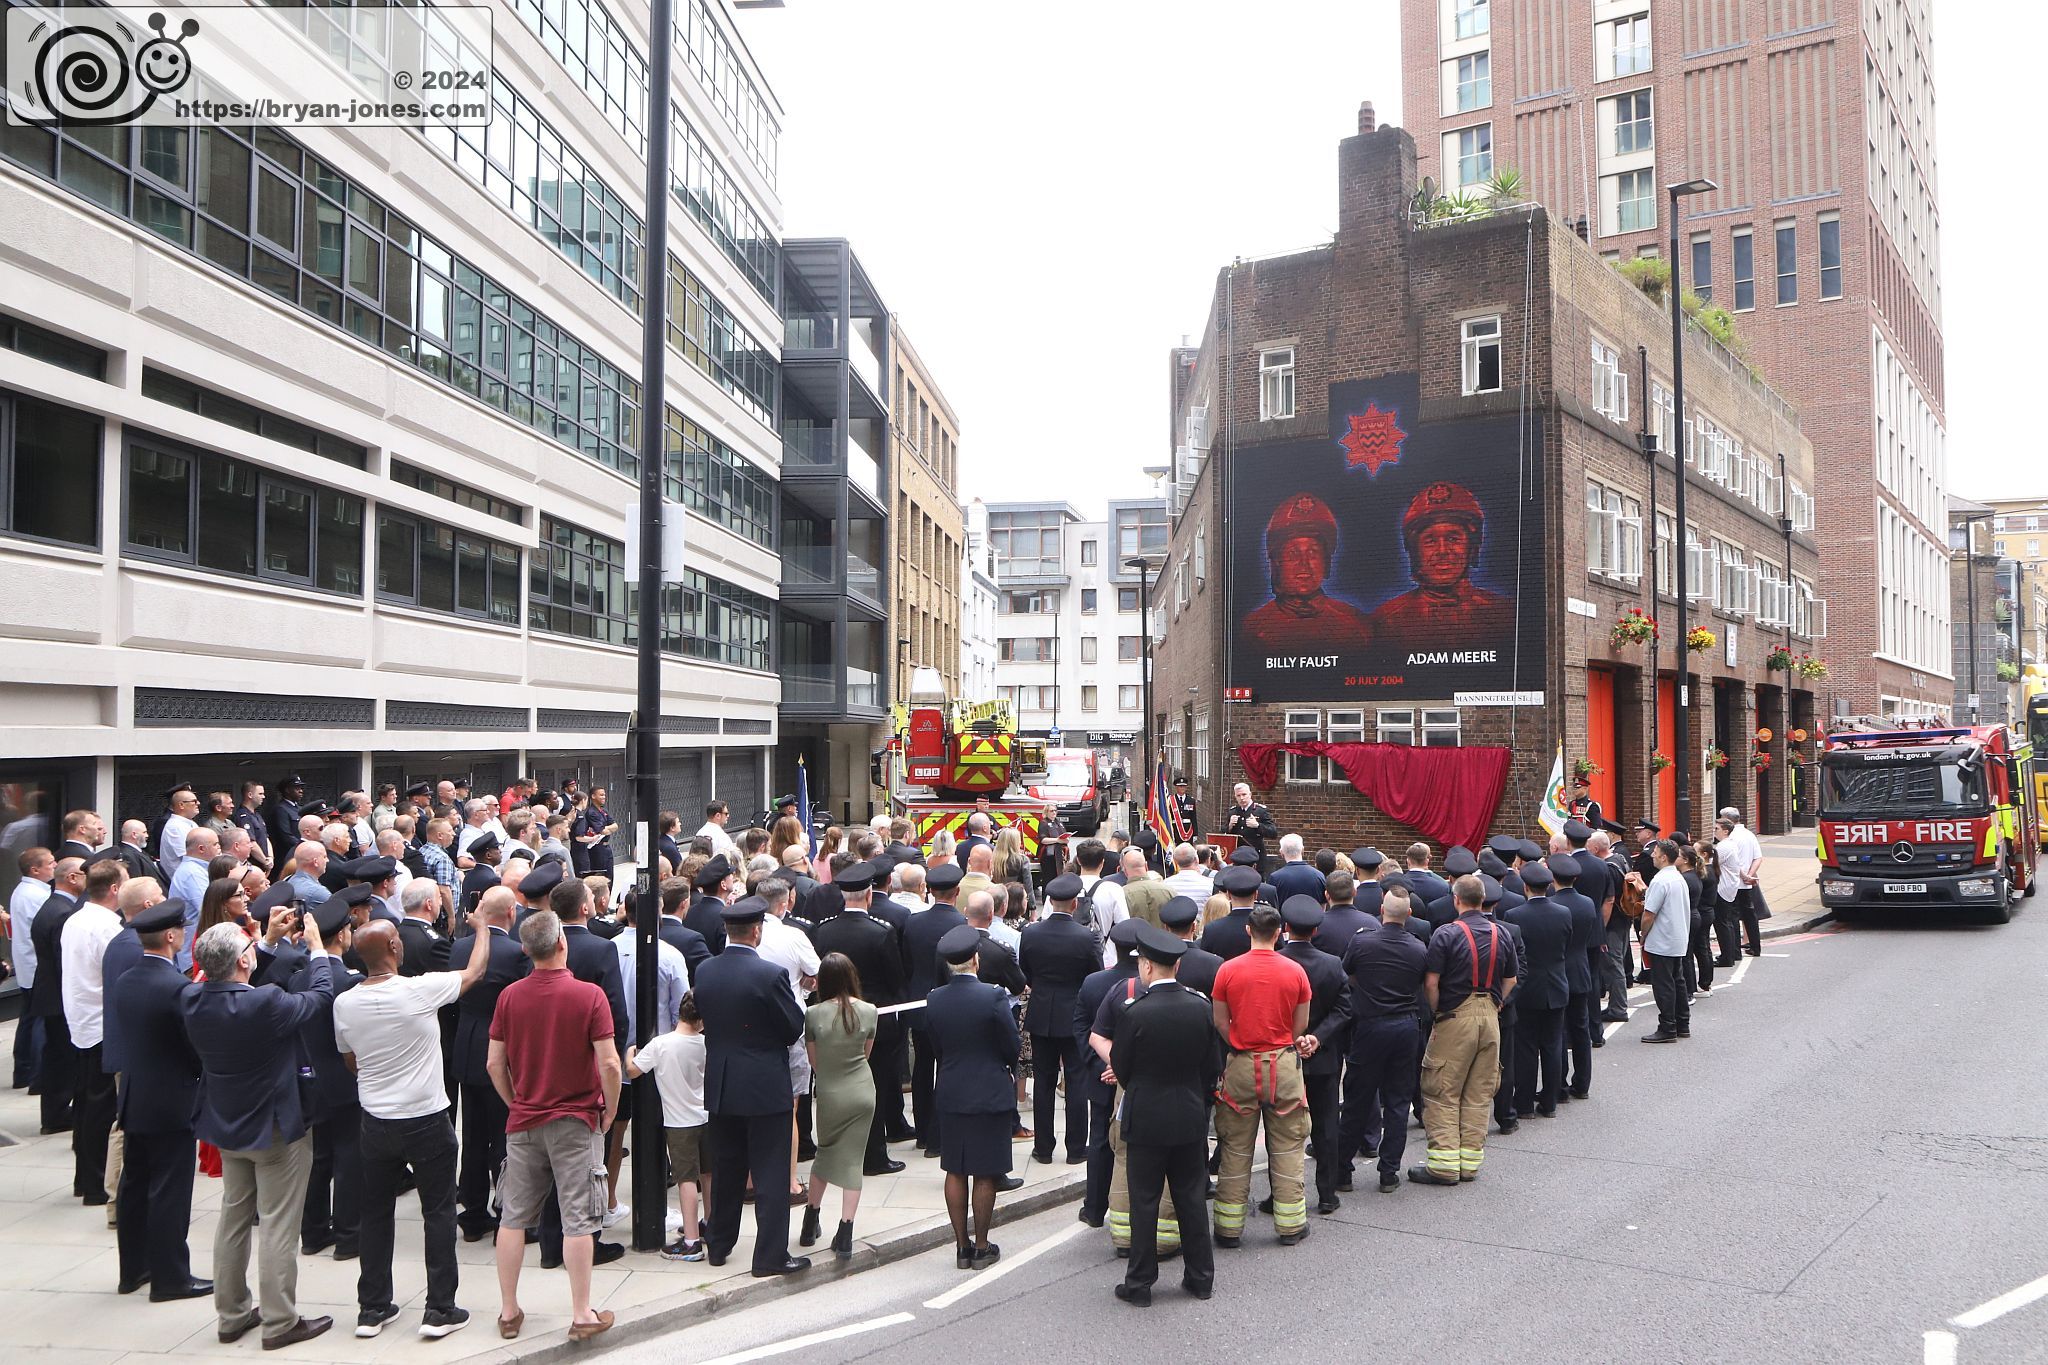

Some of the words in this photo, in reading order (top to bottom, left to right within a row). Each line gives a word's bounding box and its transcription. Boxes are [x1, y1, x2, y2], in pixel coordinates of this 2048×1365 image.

[1266, 657, 1297, 669] BILLY
[1300, 655, 1339, 668] FAUST
[1406, 652, 1449, 665] ADAM
[1452, 650, 1497, 664] MEERE
[1344, 677, 1356, 686] 20
[1358, 676, 1379, 686] JULY
[1381, 675, 1404, 685] 2004
[1863, 751, 1932, 762] london-fire.gov.uk
[1915, 822, 1973, 842] FIRE
